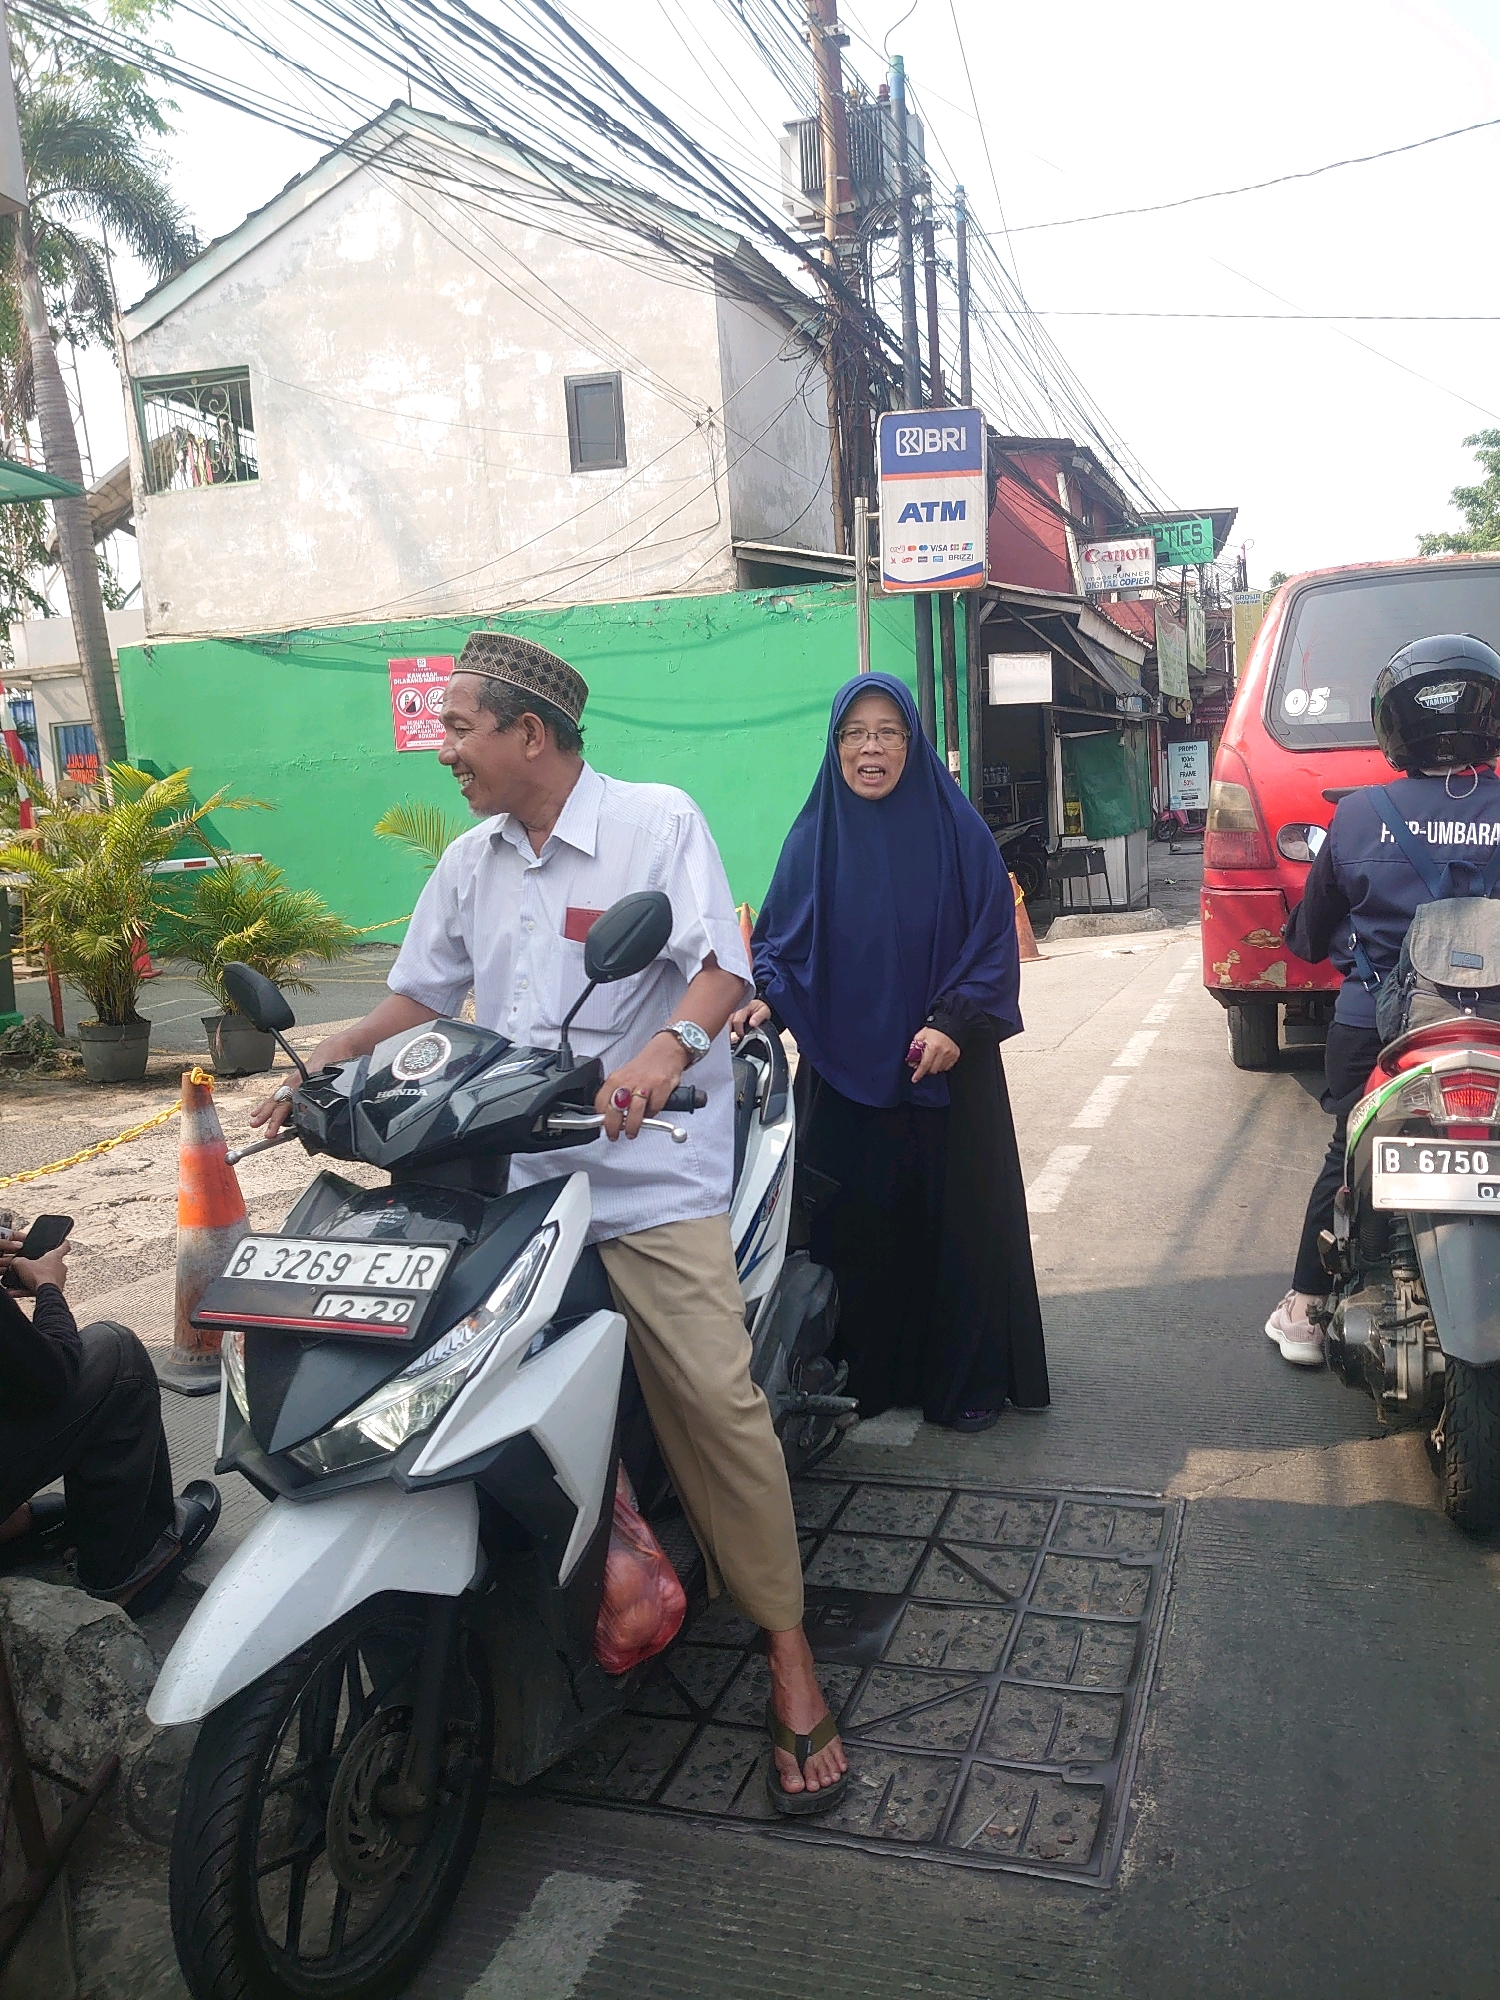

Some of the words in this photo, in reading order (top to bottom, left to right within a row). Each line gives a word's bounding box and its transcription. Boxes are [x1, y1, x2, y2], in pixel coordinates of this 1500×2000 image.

[924, 427, 966, 453] BRI
[897, 500, 966, 523] ATM
[930, 544, 948, 552] VISA
[1084, 546, 1150, 564] Canon
[948, 553, 974, 561] BRIZZI
[1086, 580, 1118, 590] DIGITAL
[1119, 576, 1150, 587] COPIER
[1235, 593, 1261, 601] GROSIR
[424, 675, 453, 683] MEROKO
[1285, 686, 1331, 717] 05
[1425, 696, 1454, 706] YAMAHA
[375, 1088, 430, 1100] HONDA
[1385, 1148, 1400, 1173] B
[1418, 1149, 1489, 1174] 6750
[231, 1246, 258, 1277] B
[264, 1247, 352, 1283] 3269
[363, 1252, 434, 1288] EJR
